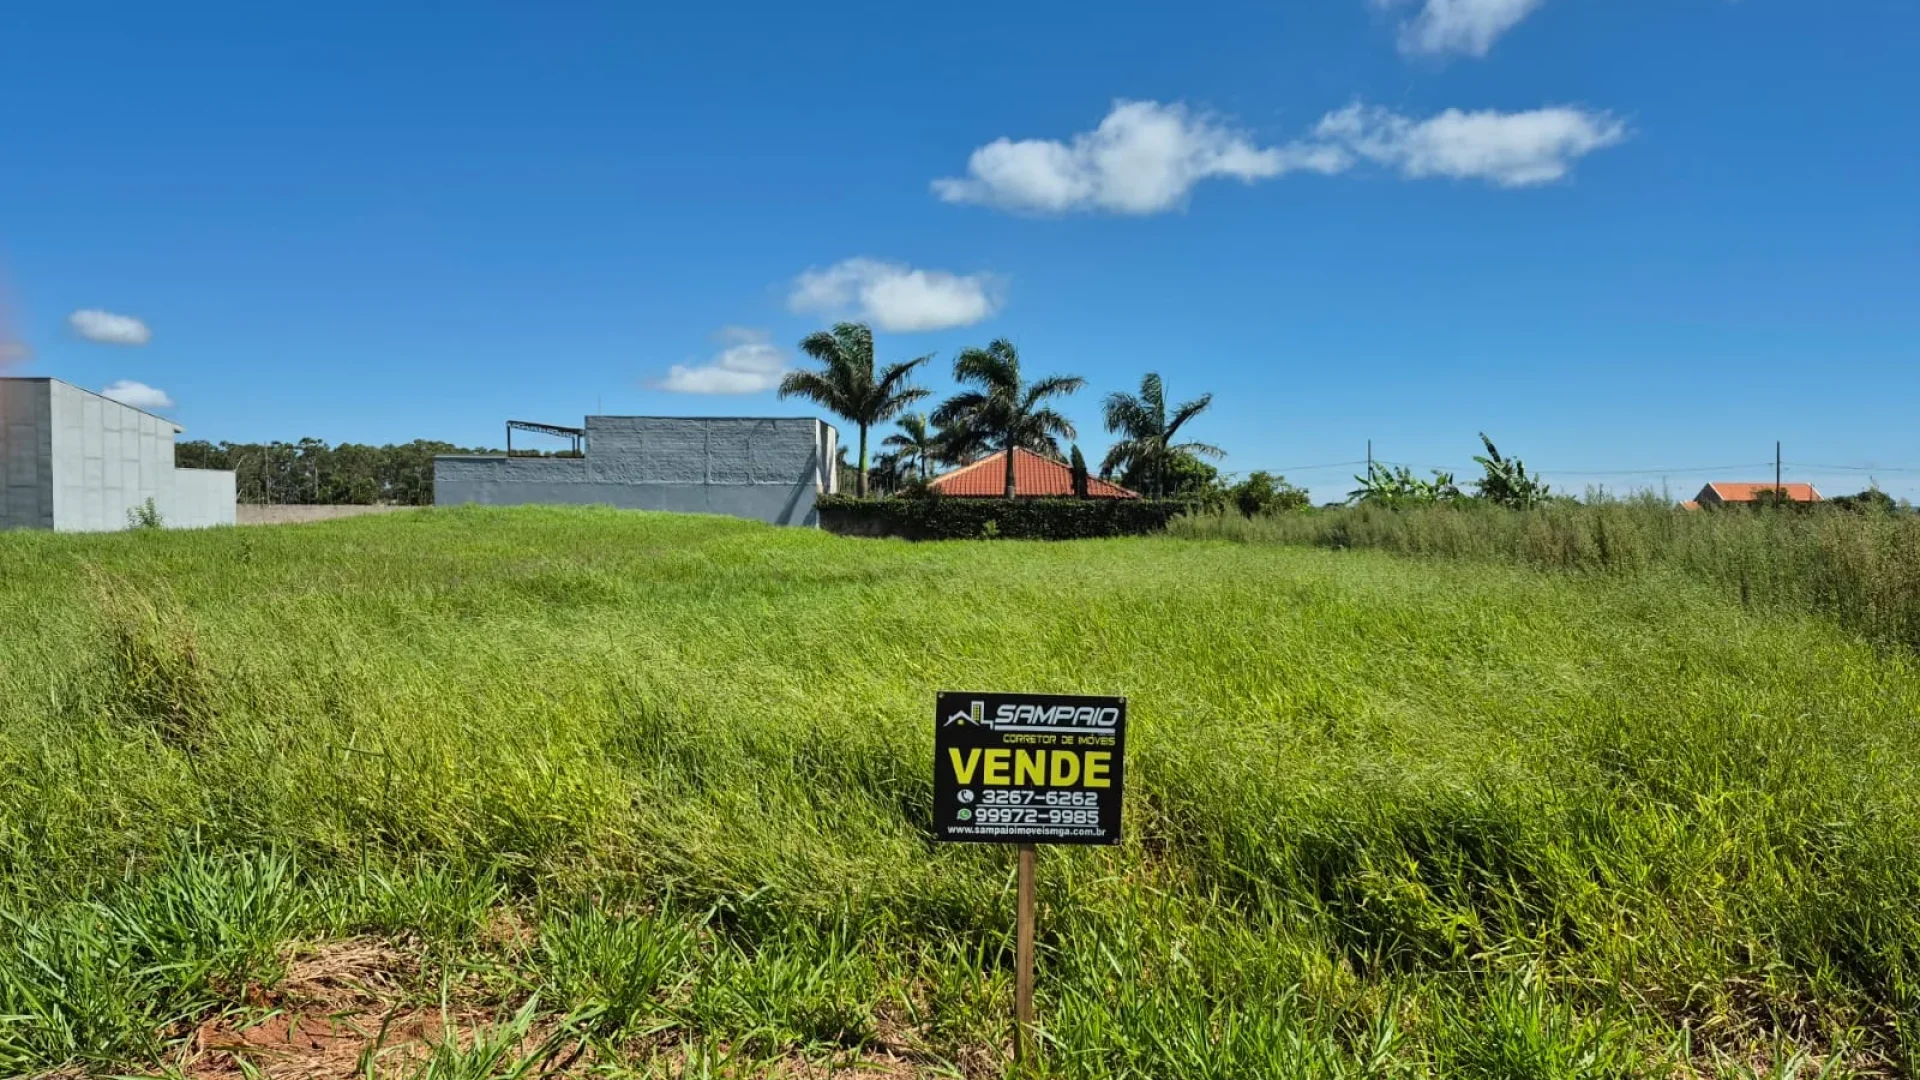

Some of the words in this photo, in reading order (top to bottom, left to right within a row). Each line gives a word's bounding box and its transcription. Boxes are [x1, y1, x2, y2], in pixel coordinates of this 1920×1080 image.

[995, 704, 1119, 726] SAMPAIO
[1003, 733, 1056, 744] CORRETOR
[1061, 735, 1074, 745] DE
[1078, 733, 1116, 746] IMÓVEIS
[948, 747, 1112, 787] VENDE
[982, 790, 1098, 806] 3267-6262
[975, 808, 1099, 824] 99972-9985
[948, 825, 1106, 837] www.sampaioimoveismga.com.br
